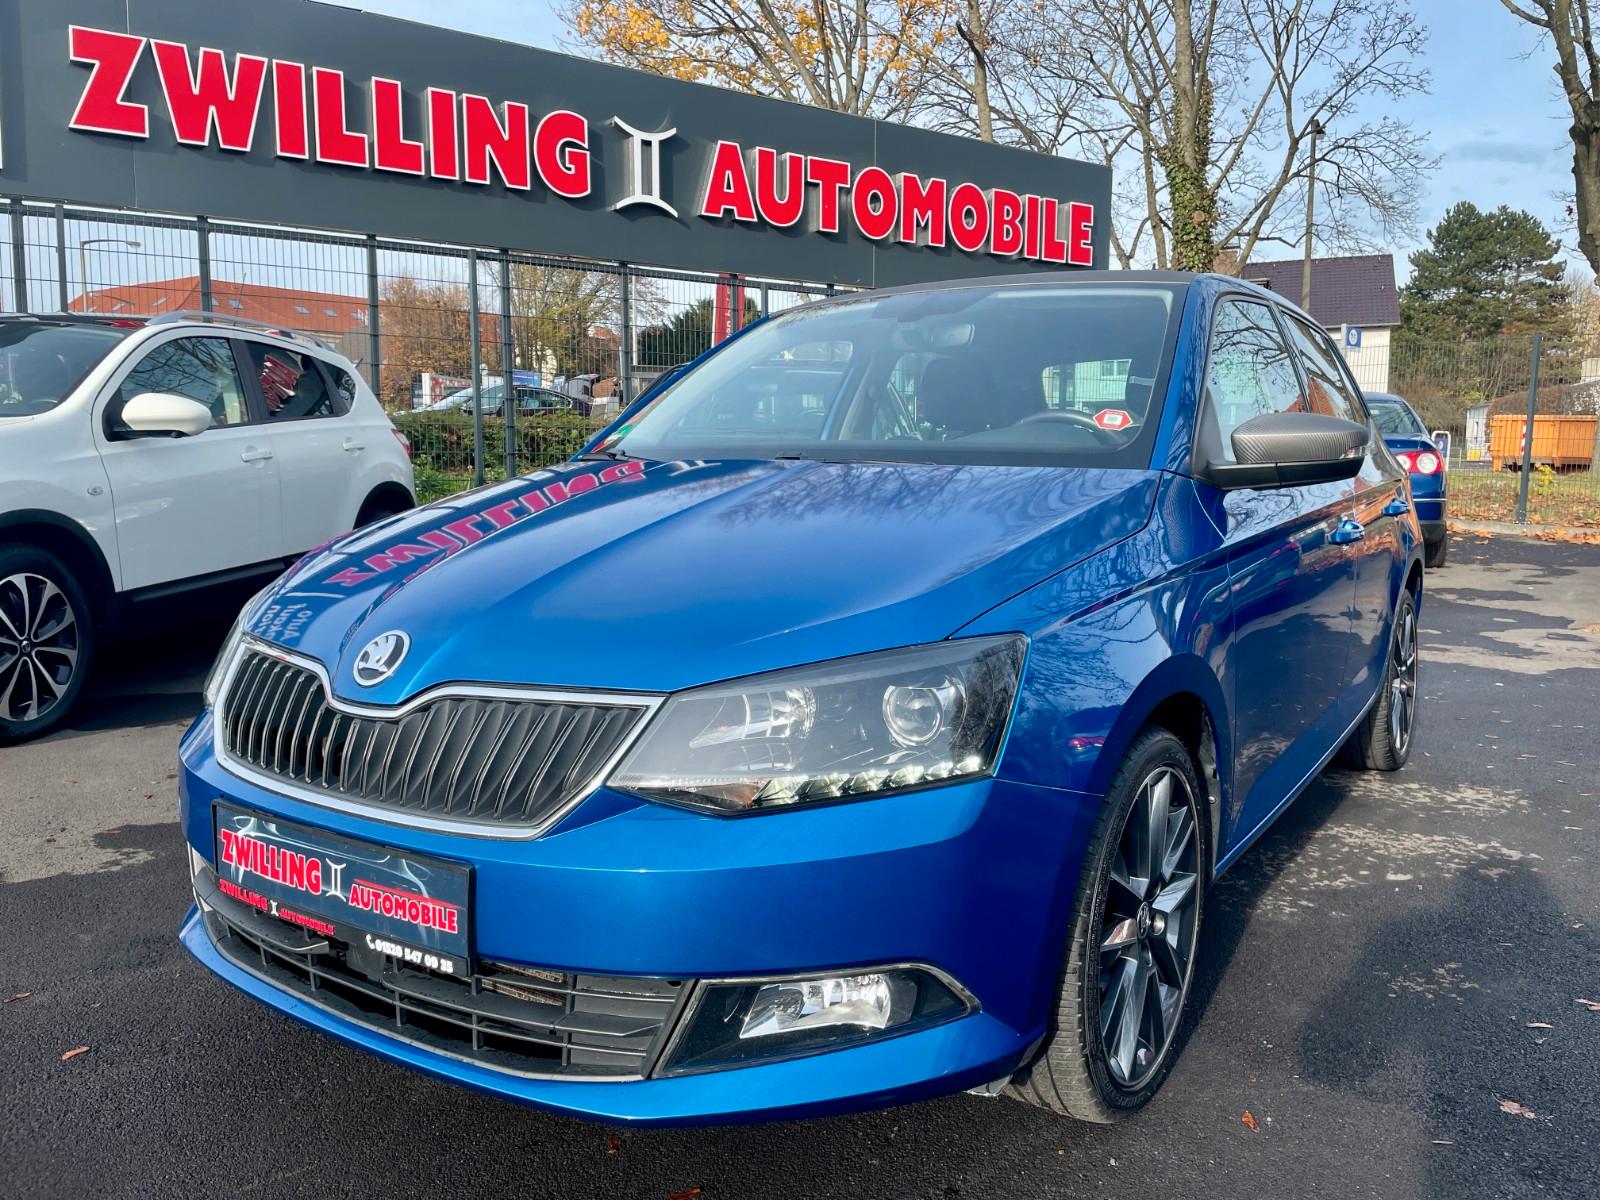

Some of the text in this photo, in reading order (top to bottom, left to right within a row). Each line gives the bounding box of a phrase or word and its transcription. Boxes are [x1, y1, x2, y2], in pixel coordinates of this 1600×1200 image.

[68, 24, 1094, 267] ZWILLING AUTOMOBILE
[219, 878, 269, 913] ZWILLING
[221, 828, 458, 935] ZWILLING AUTOMOBILE
